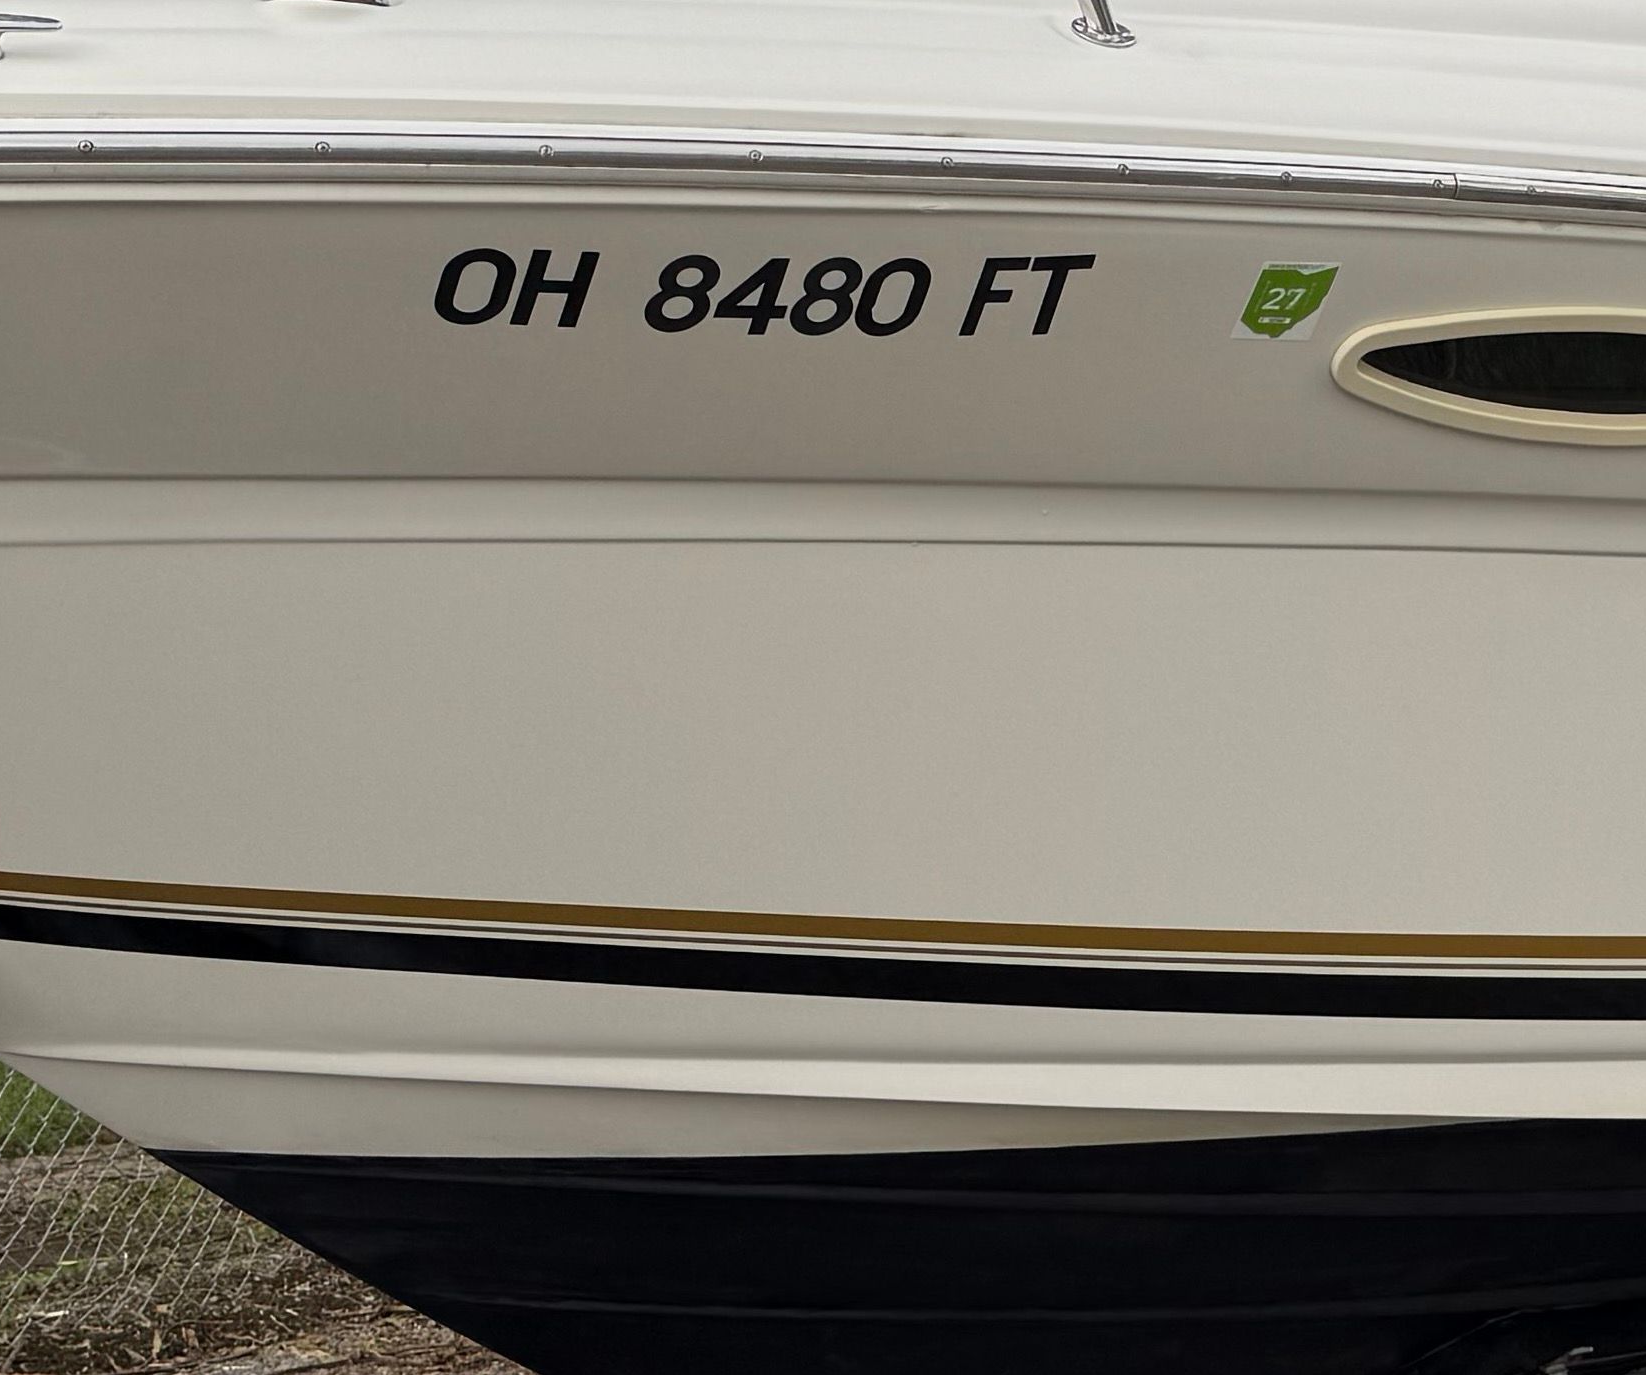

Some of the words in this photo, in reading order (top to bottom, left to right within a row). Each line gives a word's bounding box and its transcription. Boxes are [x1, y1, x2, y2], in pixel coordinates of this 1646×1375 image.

[434, 248, 600, 327] OH
[645, 255, 931, 336] 8480
[959, 255, 1096, 336] FT
[1260, 287, 1306, 310] 27
